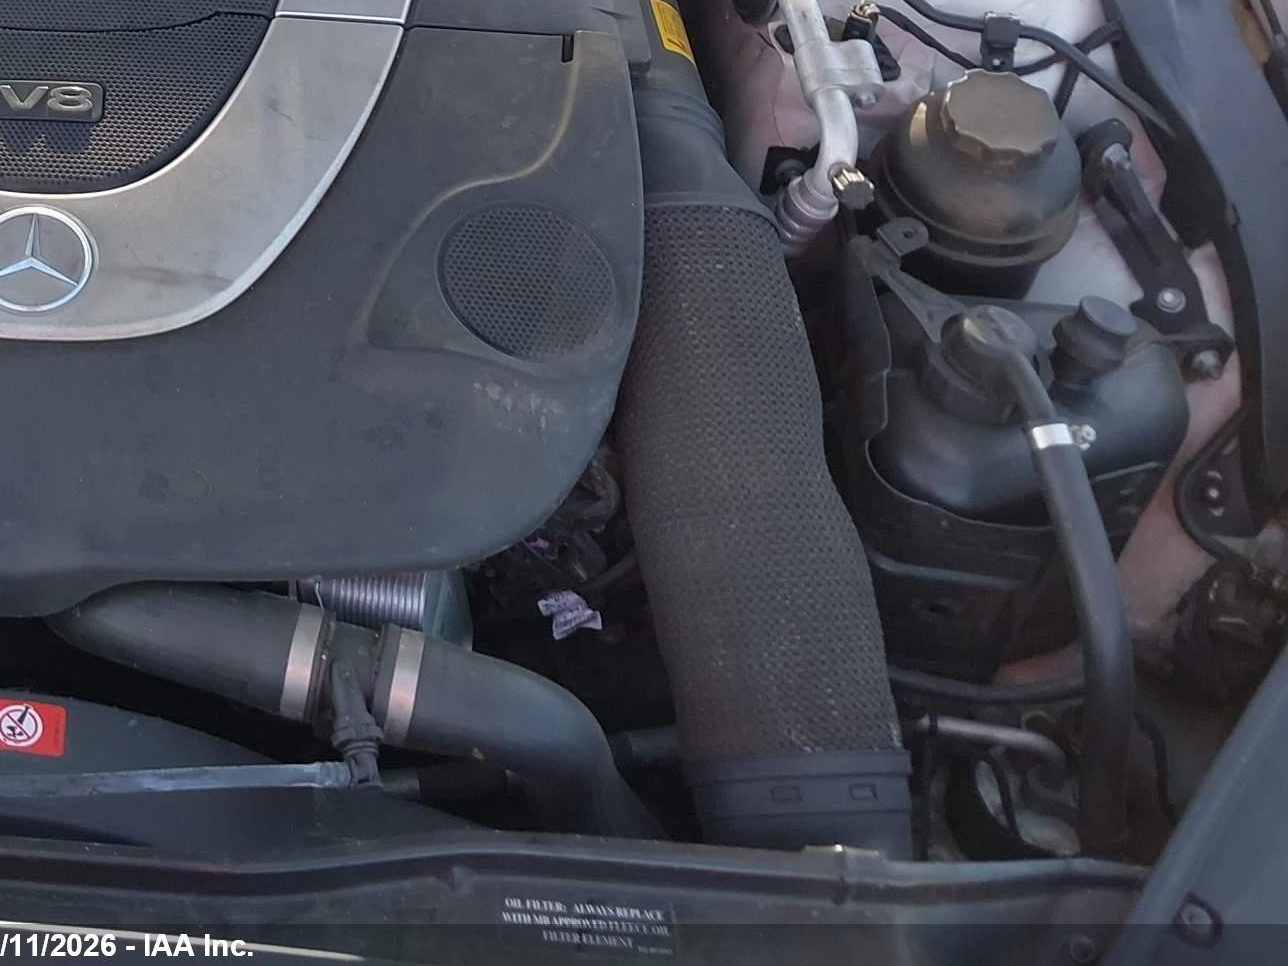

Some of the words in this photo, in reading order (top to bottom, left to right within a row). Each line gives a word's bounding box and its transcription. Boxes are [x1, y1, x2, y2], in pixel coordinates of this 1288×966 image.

[0, 84, 93, 112] V8
[502, 911, 532, 925] WITH
[573, 903, 615, 917] ALWAYS
[615, 906, 665, 922] REPLACE
[542, 929, 582, 943] FILTER
